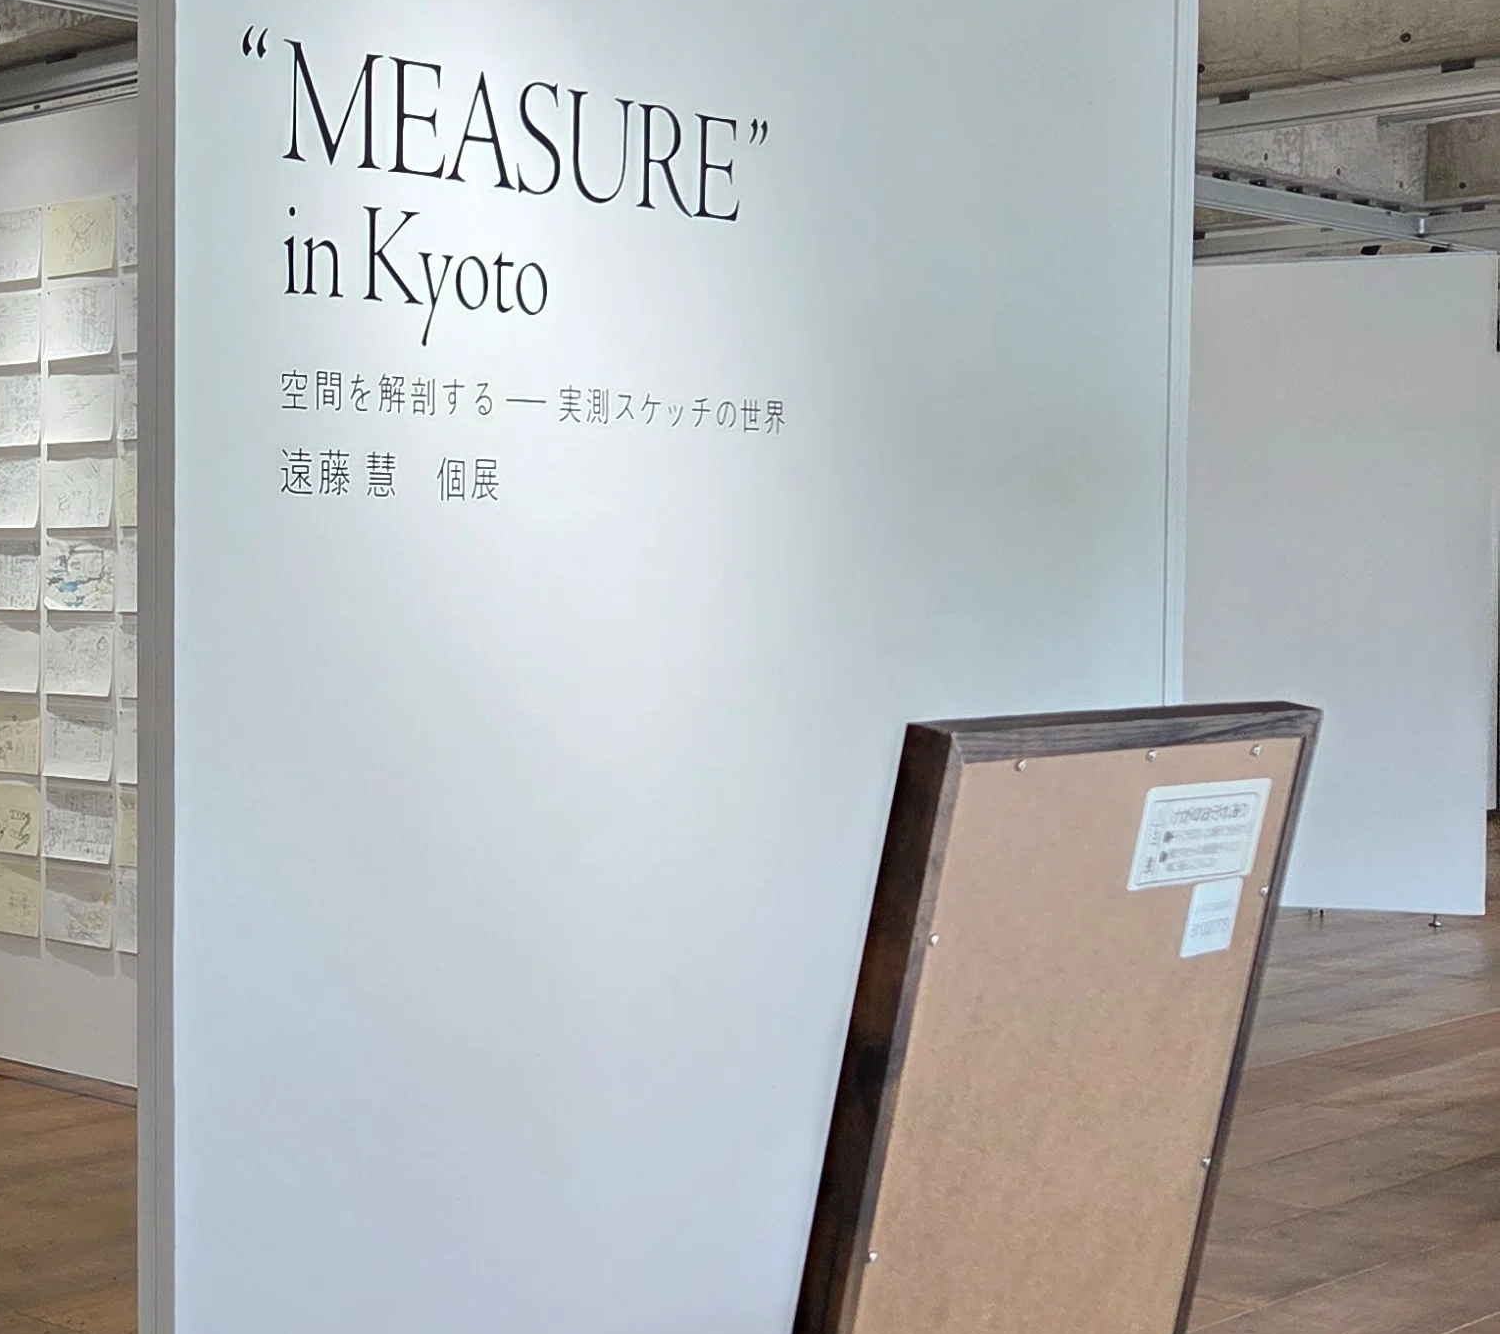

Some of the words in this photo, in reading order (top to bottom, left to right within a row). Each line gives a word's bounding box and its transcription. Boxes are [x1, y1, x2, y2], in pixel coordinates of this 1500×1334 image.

[241, 24, 770, 222] “MEASURE”
[283, 206, 344, 299] in
[362, 205, 548, 348] Kyoto
[280, 447, 351, 497] 遠藤
[366, 450, 397, 499] 慧
[436, 456, 501, 503] 個展
